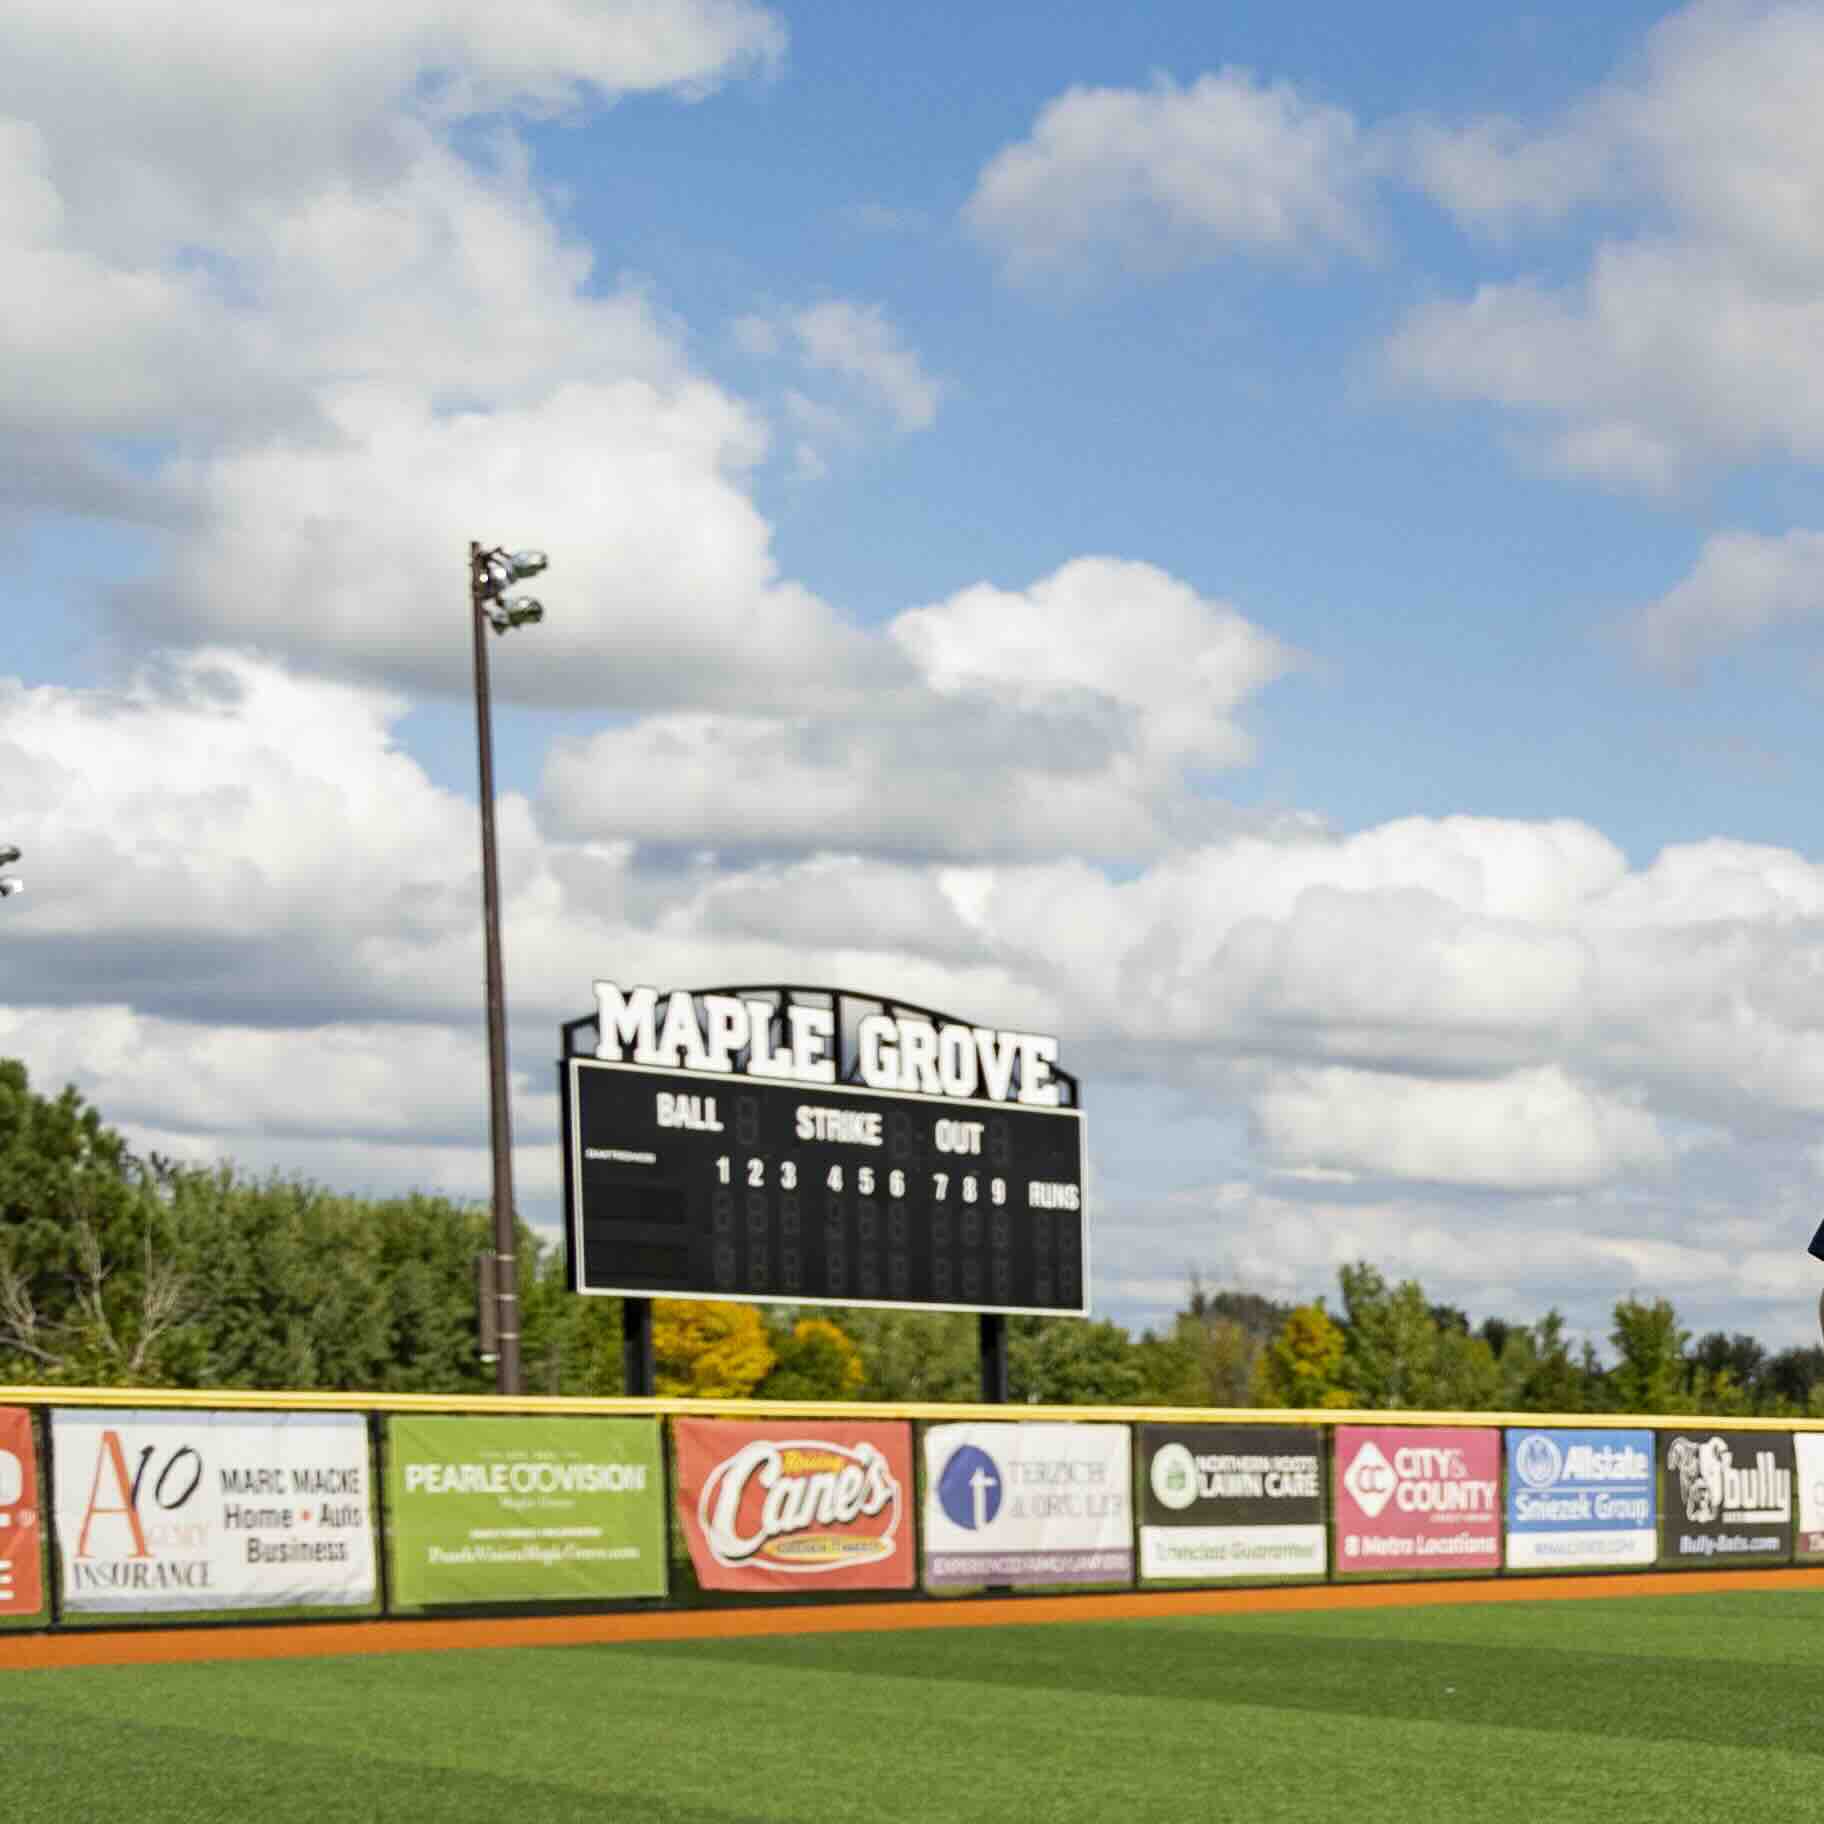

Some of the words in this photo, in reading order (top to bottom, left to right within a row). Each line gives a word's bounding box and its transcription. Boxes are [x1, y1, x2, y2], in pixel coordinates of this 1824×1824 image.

[593, 980, 836, 1083] MAPLE
[858, 1014, 1060, 1107] GROVE
[656, 1092, 724, 1132] BALL
[796, 1105, 883, 1146] STRIKE
[935, 1118, 985, 1155] OUT
[716, 1155, 730, 1185] 1
[747, 1157, 765, 1188] 2
[780, 1160, 797, 1190] 3
[826, 1164, 844, 1193] 4
[858, 1166, 876, 1196] 5
[889, 1168, 906, 1199] 6
[933, 1172, 949, 1201] 7
[962, 1175, 978, 1204] 8
[991, 1177, 1006, 1206] 9
[1028, 1180, 1080, 1212] RUNS
[1394, 1448, 1452, 1479] CITY
[1561, 1443, 1649, 1480] Allstate
[220, 1467, 286, 1495] MARC
[1197, 1472, 1265, 1498] LAWN
[1264, 1472, 1320, 1497] CARE
[1396, 1480, 1498, 1512] COUNTY
[1721, 1451, 1792, 1523] bully
[224, 1503, 293, 1529] Home
[319, 1502, 362, 1528] Auto
[1594, 1493, 1650, 1527] Group
[246, 1537, 346, 1564] Business
[1416, 1532, 1497, 1556] Locations
[73, 1561, 213, 1589] INSURANCE
